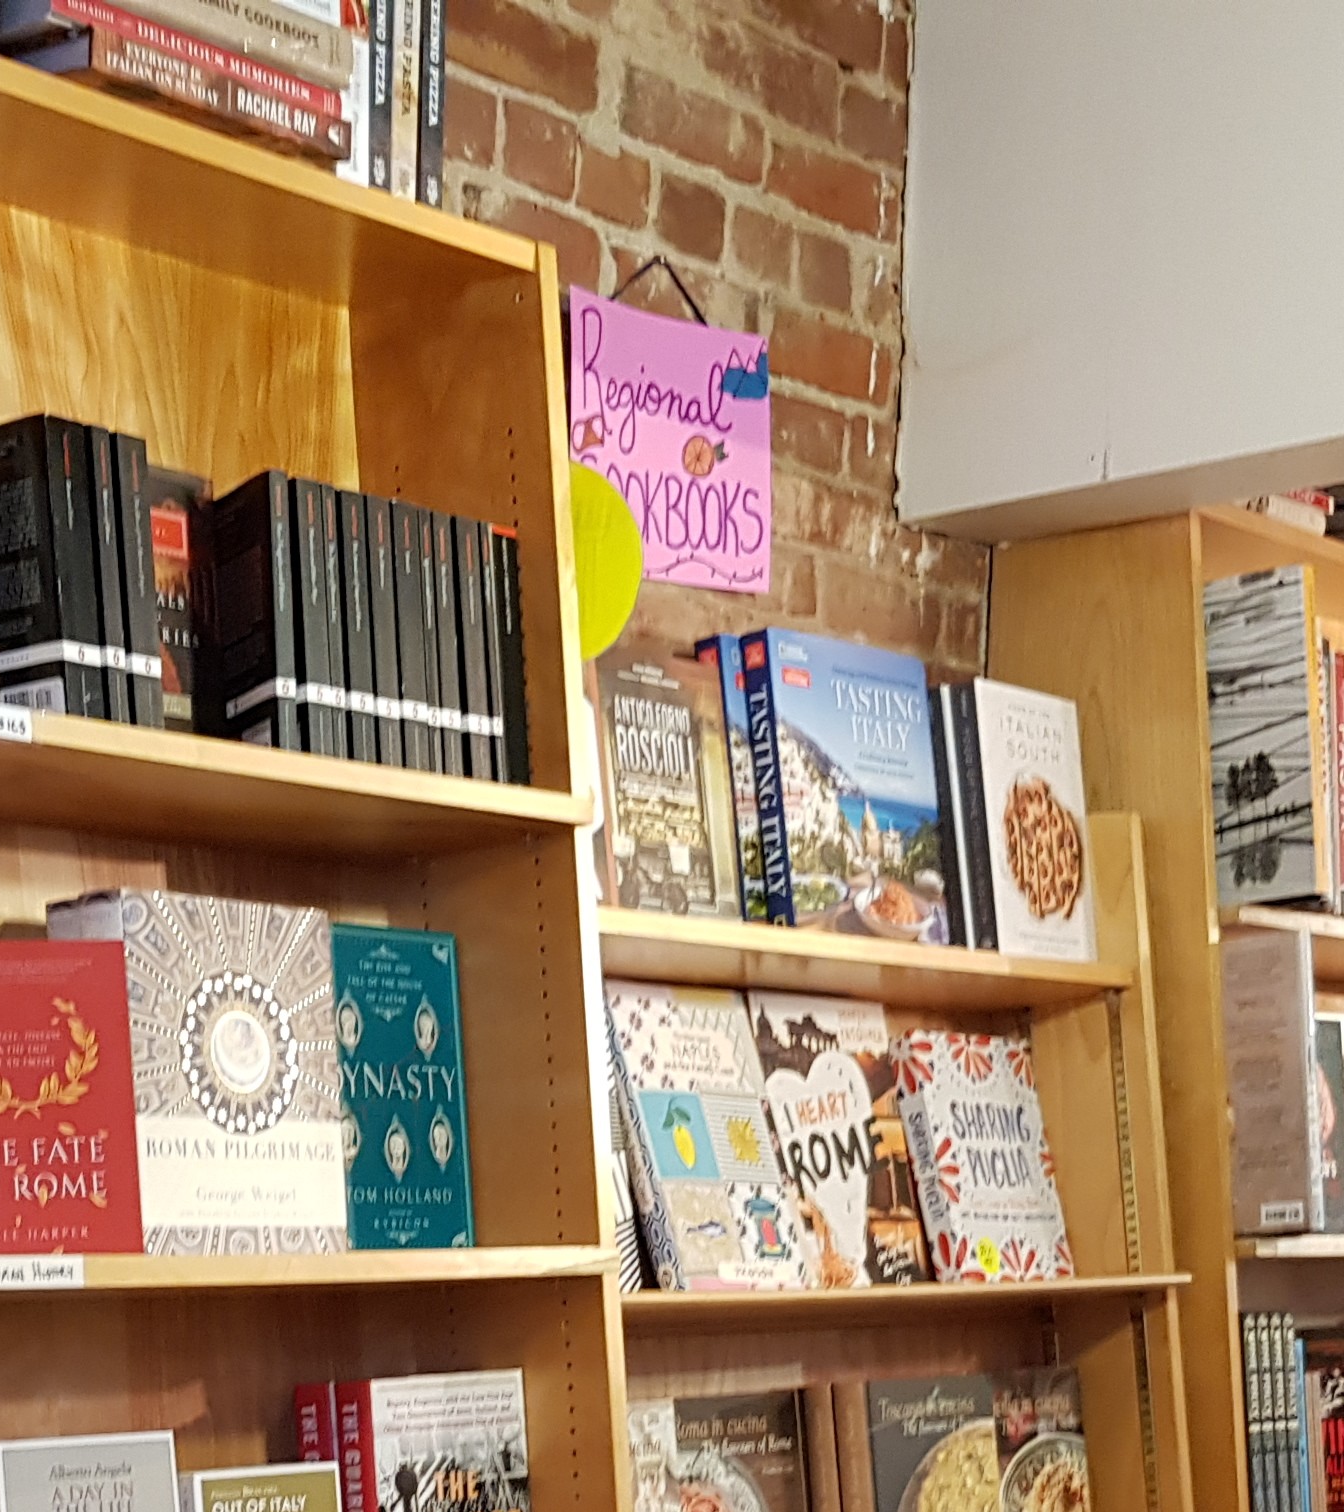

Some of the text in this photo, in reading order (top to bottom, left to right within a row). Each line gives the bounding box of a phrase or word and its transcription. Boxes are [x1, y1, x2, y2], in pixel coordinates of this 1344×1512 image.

[125, 41, 188, 77] EVERYONE
[137, 21, 311, 101] DELICIOUS MEMORIES
[375, 46, 387, 105] PIZZA
[106, 52, 220, 108] ITALIAN ON SUNDAY
[401, 53, 413, 117] PASTA
[429, 65, 440, 127] PIZZA
[237, 89, 318, 138] RACHAEL RAY
[580, 306, 733, 456] Regional
[615, 694, 690, 736] ANTICO FORNO
[831, 679, 922, 723] TASTING
[616, 725, 696, 781] ROSCIOLI
[851, 717, 911, 751] ITALY
[1007, 740, 1061, 764] SOUTH
[749, 683, 788, 897] TASTING ITALY
[796, 1091, 848, 1125] HEART
[949, 1101, 1030, 1142] SHARING
[31, 1136, 106, 1165] FATE
[146, 1137, 336, 1162] ROMAN PILGRIMAGE
[787, 1115, 888, 1197] ROME
[967, 1147, 1032, 1188] PUGLIA
[13, 1169, 106, 1201] ROME
[384, 1185, 453, 1205] HOLLAND
[300, 1404, 318, 1444] THE
[341, 1404, 358, 1444] THE
[92, 1461, 133, 1479] Angela
[434, 1470, 480, 1501] THE
[52, 1481, 134, 1503] A DAY IN
[269, 1495, 307, 1512] ITALY
